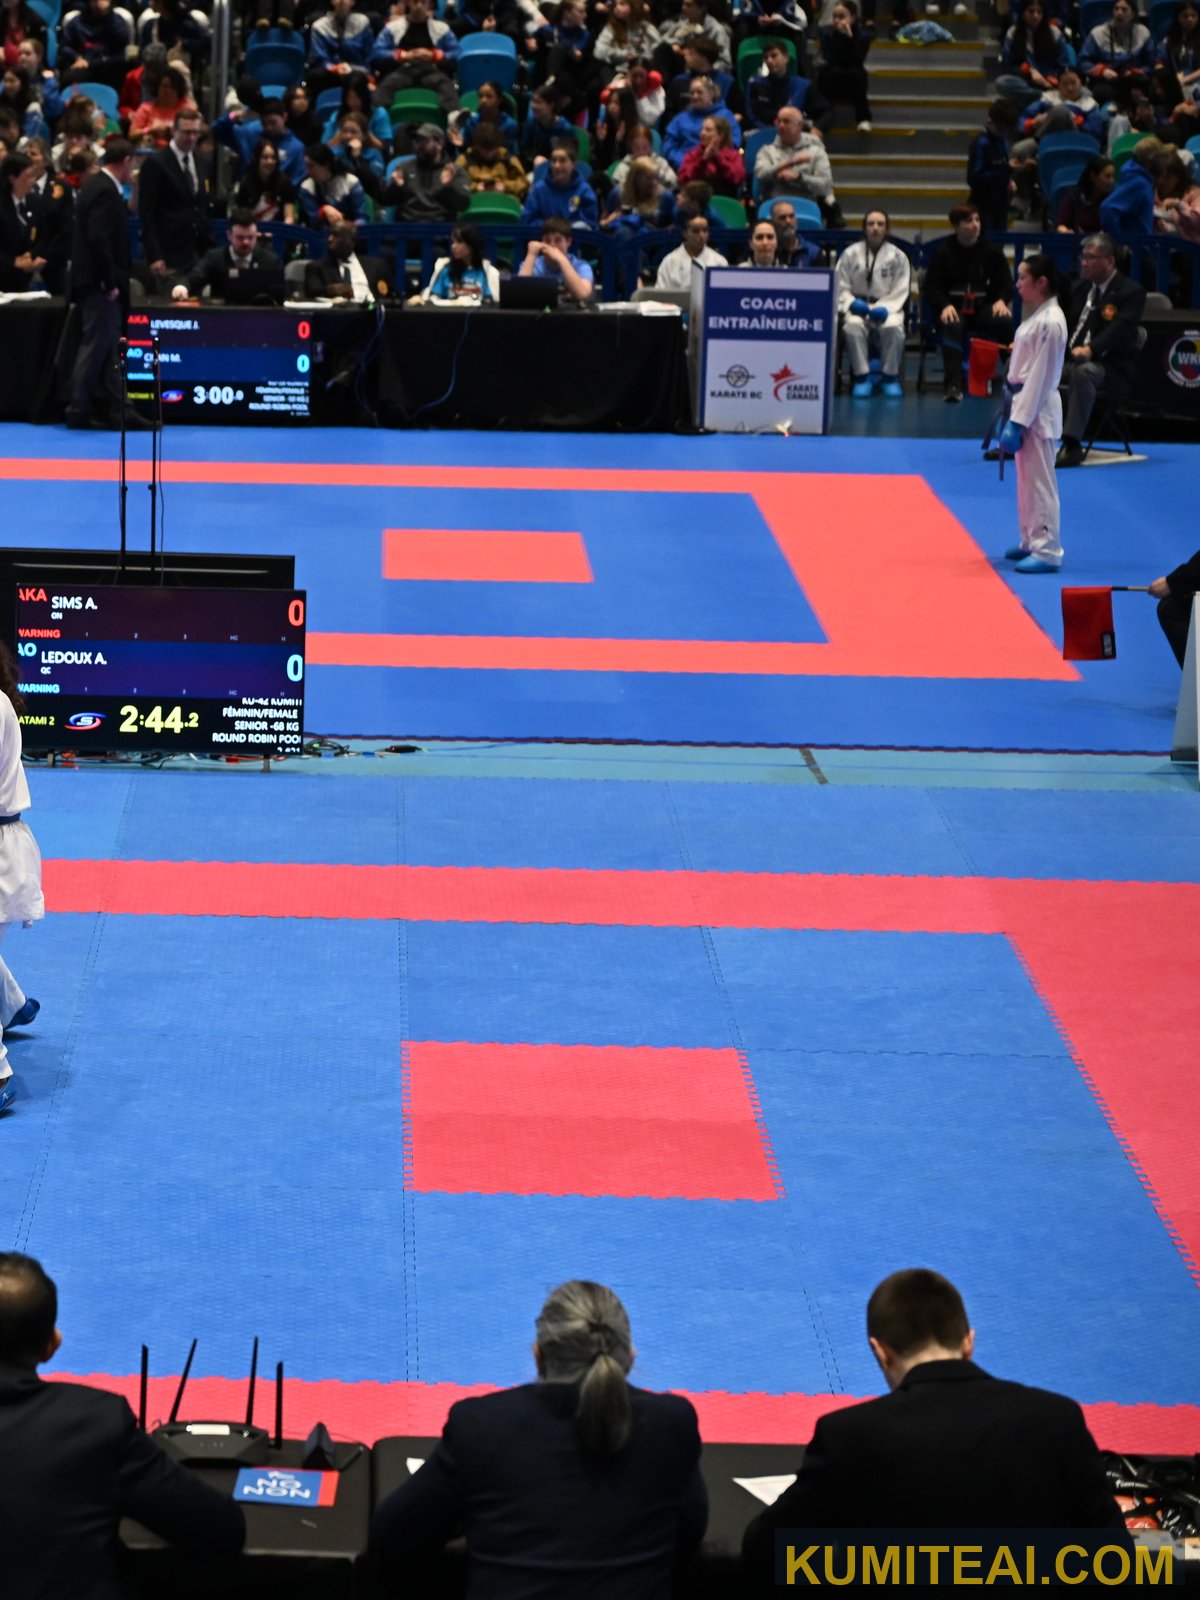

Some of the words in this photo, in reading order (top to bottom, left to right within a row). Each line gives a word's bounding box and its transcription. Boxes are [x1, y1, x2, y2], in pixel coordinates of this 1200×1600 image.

[740, 297, 797, 311] COACH
[298, 321, 311, 339] 0
[297, 354, 310, 373] 0
[787, 384, 819, 392] KARATE
[710, 391, 747, 399] KARATE
[750, 391, 762, 399] BC
[787, 392, 820, 400] CANADA
[51, 596, 83, 609] SIMS
[85, 597, 98, 610] A.
[51, 612, 63, 620] ON
[288, 599, 304, 626] 0
[41, 651, 93, 664] LEDOUX
[94, 652, 108, 665] A.
[40, 666, 52, 674] QC
[287, 654, 303, 682] 0
[222, 706, 298, 719] FÉMININ/FEMALE
[18, 716, 46, 725] ATAMI
[49, 717, 55, 726] 2
[234, 720, 268, 731] SENIOR
[269, 721, 285, 731] -68
[286, 722, 300, 732] KG
[212, 732, 247, 743] ROUND
[248, 733, 277, 744] ROBIN
